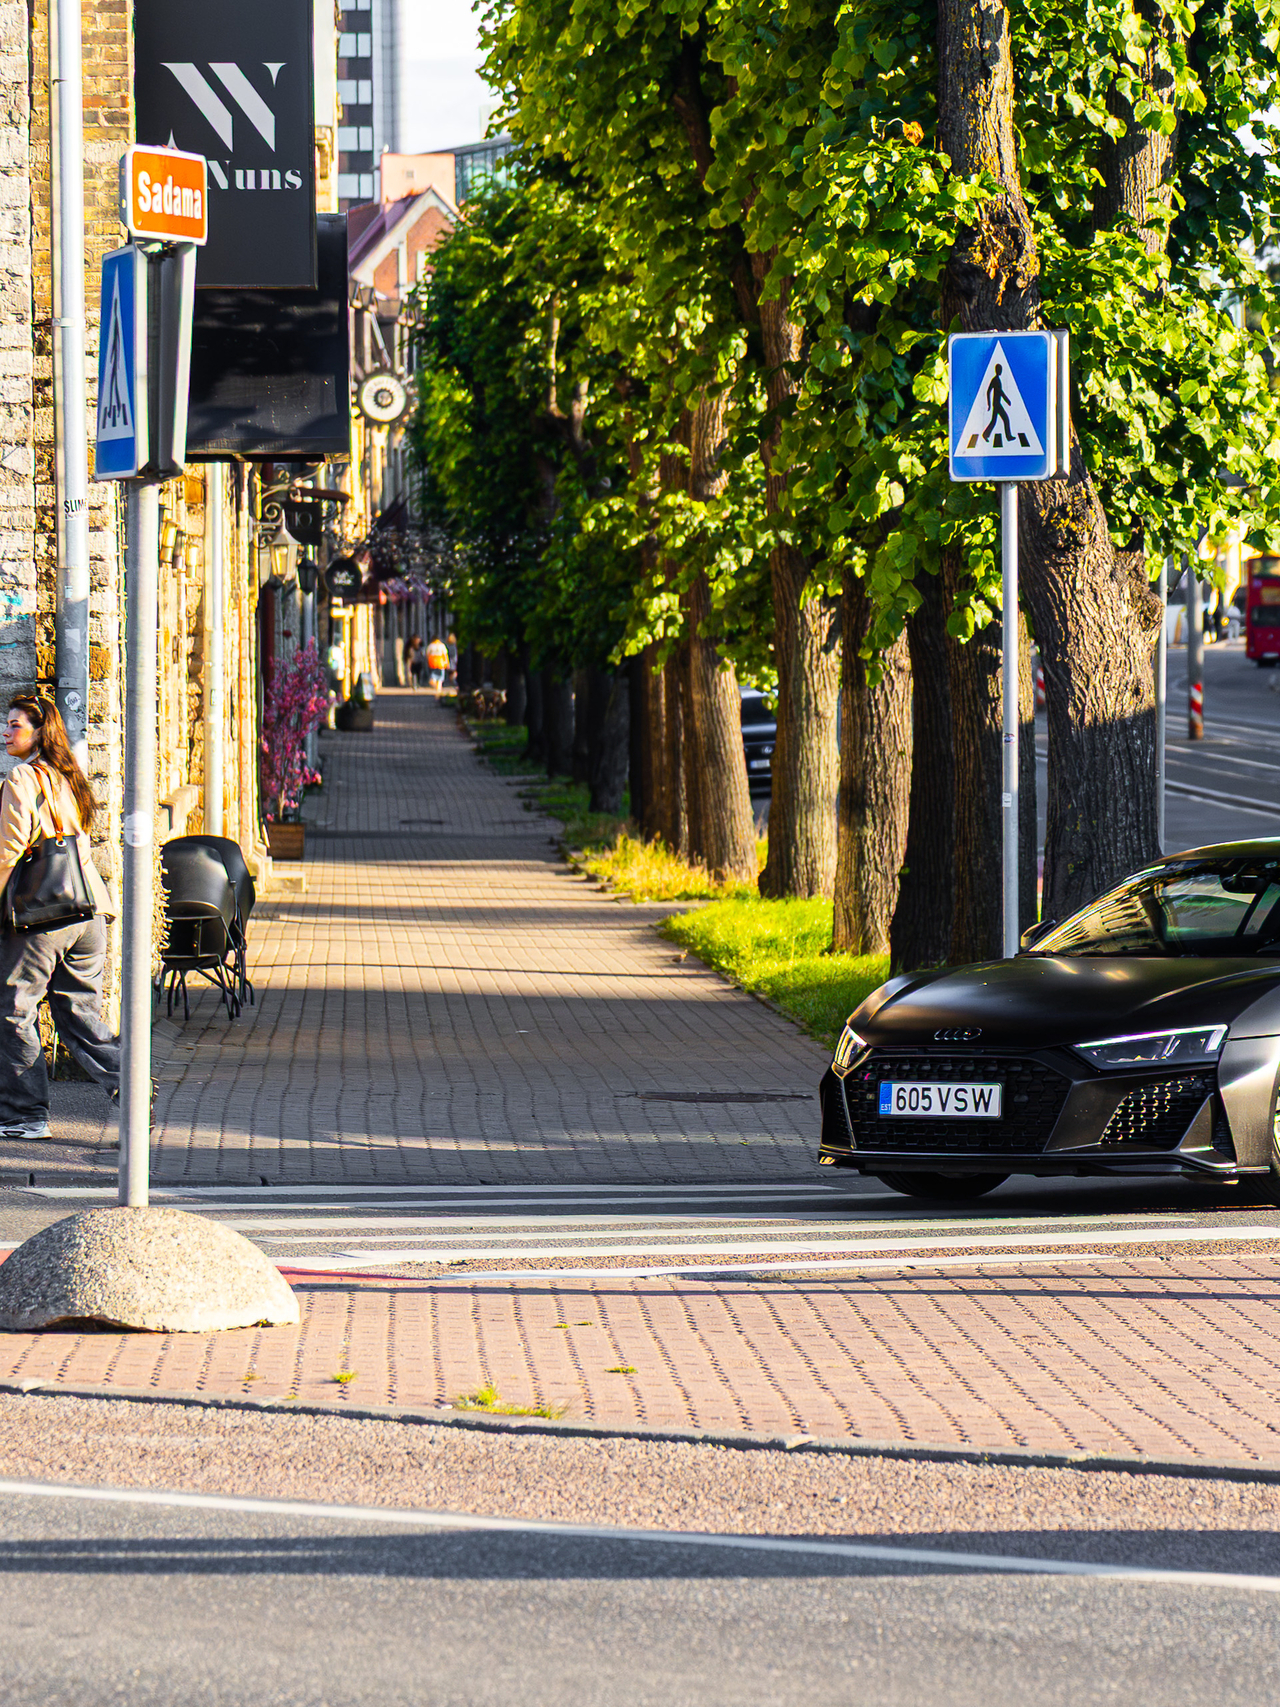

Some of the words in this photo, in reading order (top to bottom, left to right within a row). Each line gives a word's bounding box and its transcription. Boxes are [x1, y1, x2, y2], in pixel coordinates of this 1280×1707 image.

[207, 160, 303, 190] Nuns
[137, 170, 202, 220] Sadama
[64, 498, 88, 513] SLIM
[881, 1103, 892, 1111] EST
